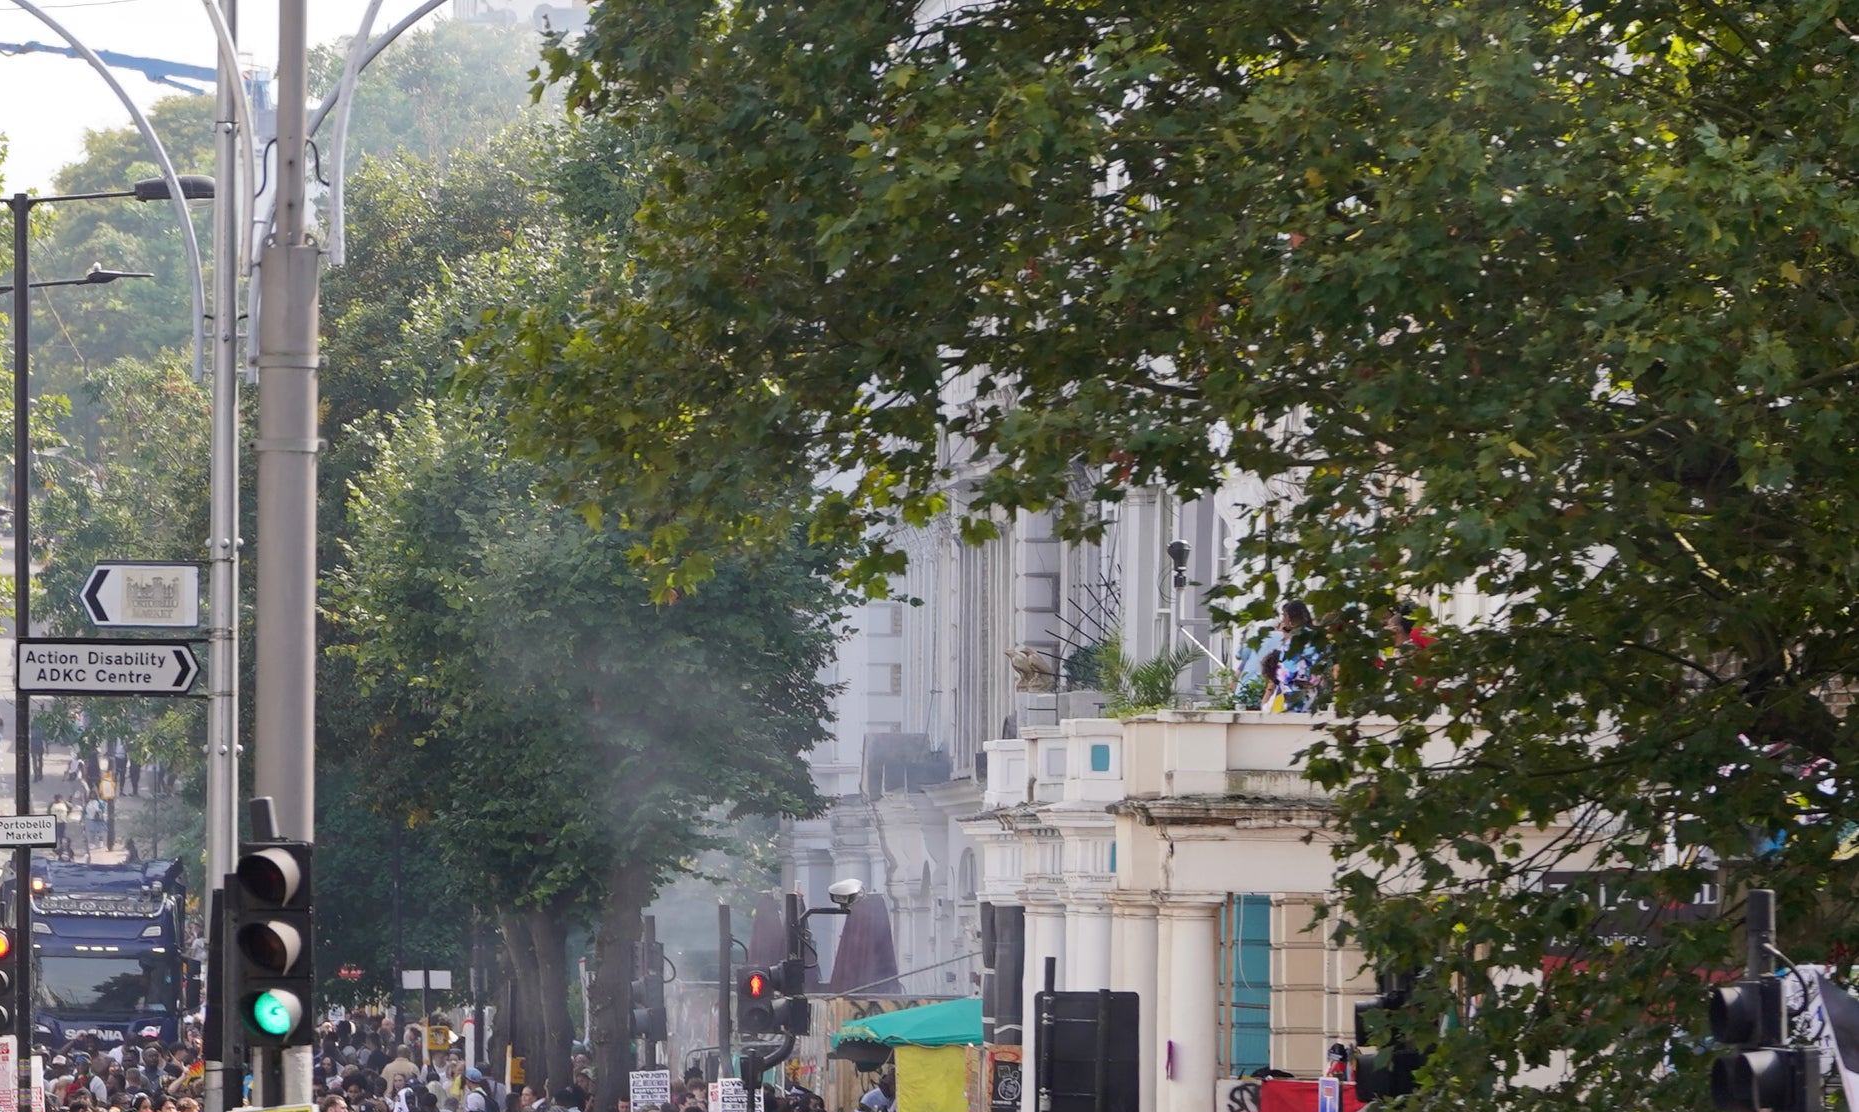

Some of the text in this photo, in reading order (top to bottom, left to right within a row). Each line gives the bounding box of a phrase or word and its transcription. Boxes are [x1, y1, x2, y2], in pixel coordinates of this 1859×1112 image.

[25, 651, 166, 668] Action Disability
[37, 669, 152, 683] ADKC Centre
[6, 831, 43, 840] Market
[65, 1029, 124, 1041] SNIA
